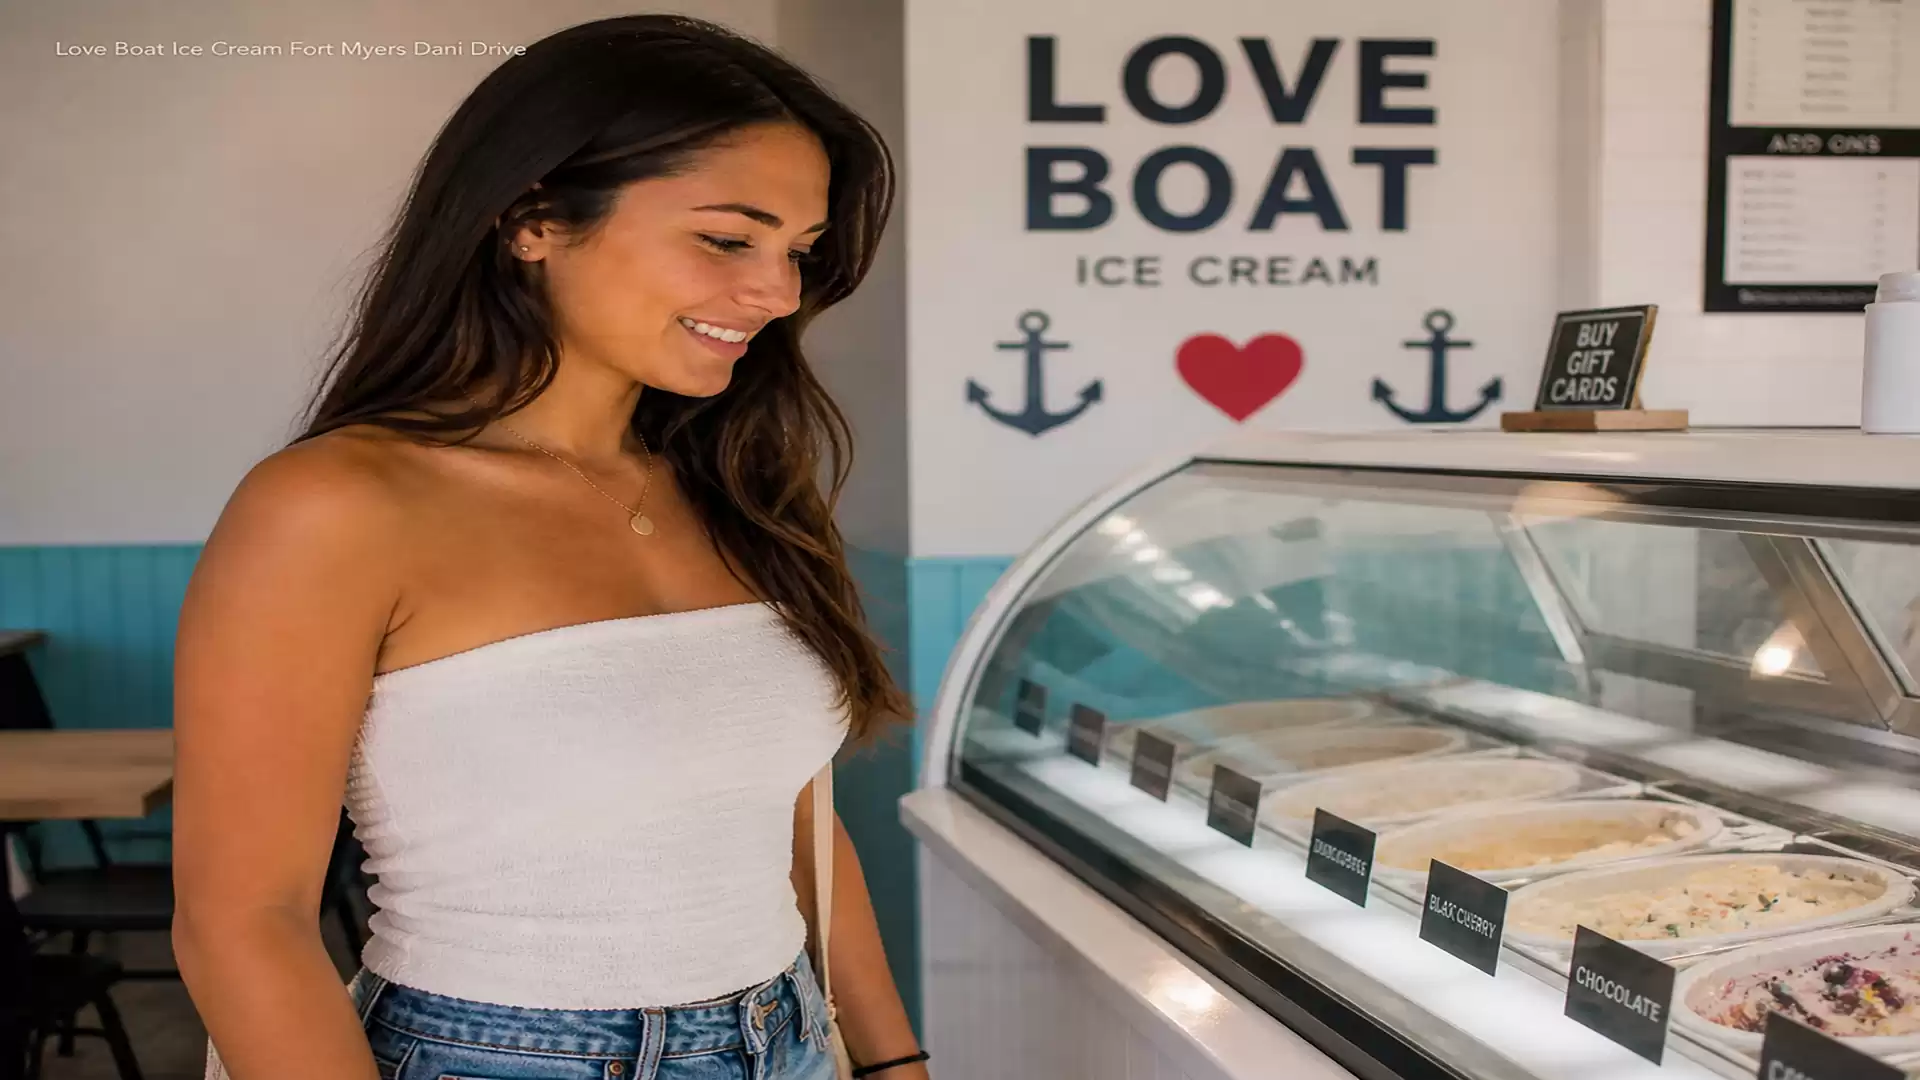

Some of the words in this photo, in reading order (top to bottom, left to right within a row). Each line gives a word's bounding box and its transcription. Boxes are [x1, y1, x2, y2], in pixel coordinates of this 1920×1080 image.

[1026, 35, 1436, 126] LOVE
[1025, 145, 1437, 233] BOAT
[1077, 256, 1160, 286] ICE
[1189, 256, 1380, 286] CREAM
[1577, 322, 1619, 348] BUY
[1567, 349, 1615, 375] GIFT
[1551, 377, 1618, 403] CARDS
[1576, 966, 1662, 1023] CHOCOLATE
